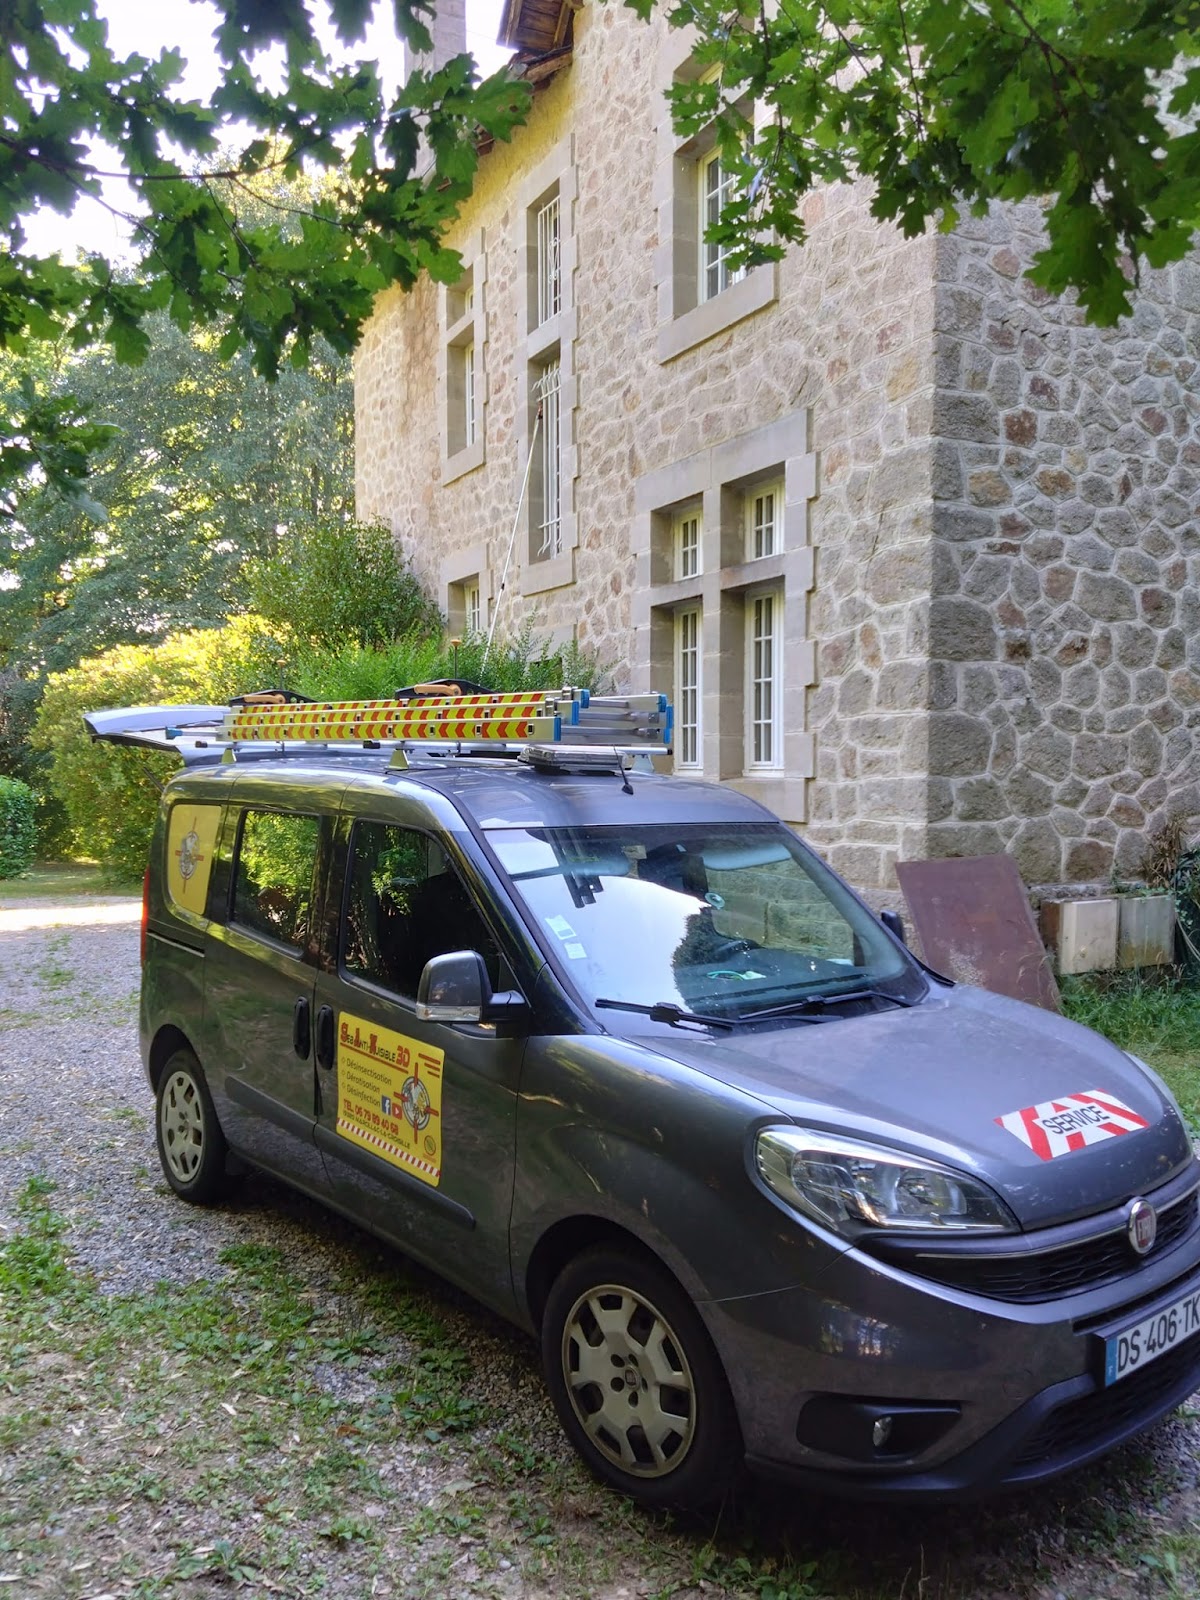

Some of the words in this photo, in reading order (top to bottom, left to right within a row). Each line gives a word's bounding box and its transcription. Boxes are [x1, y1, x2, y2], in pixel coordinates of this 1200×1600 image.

[396, 1045, 410, 1068] 3D
[346, 1058, 392, 1085] Désinsectisation
[1041, 1105, 1110, 1135] SERVICE
